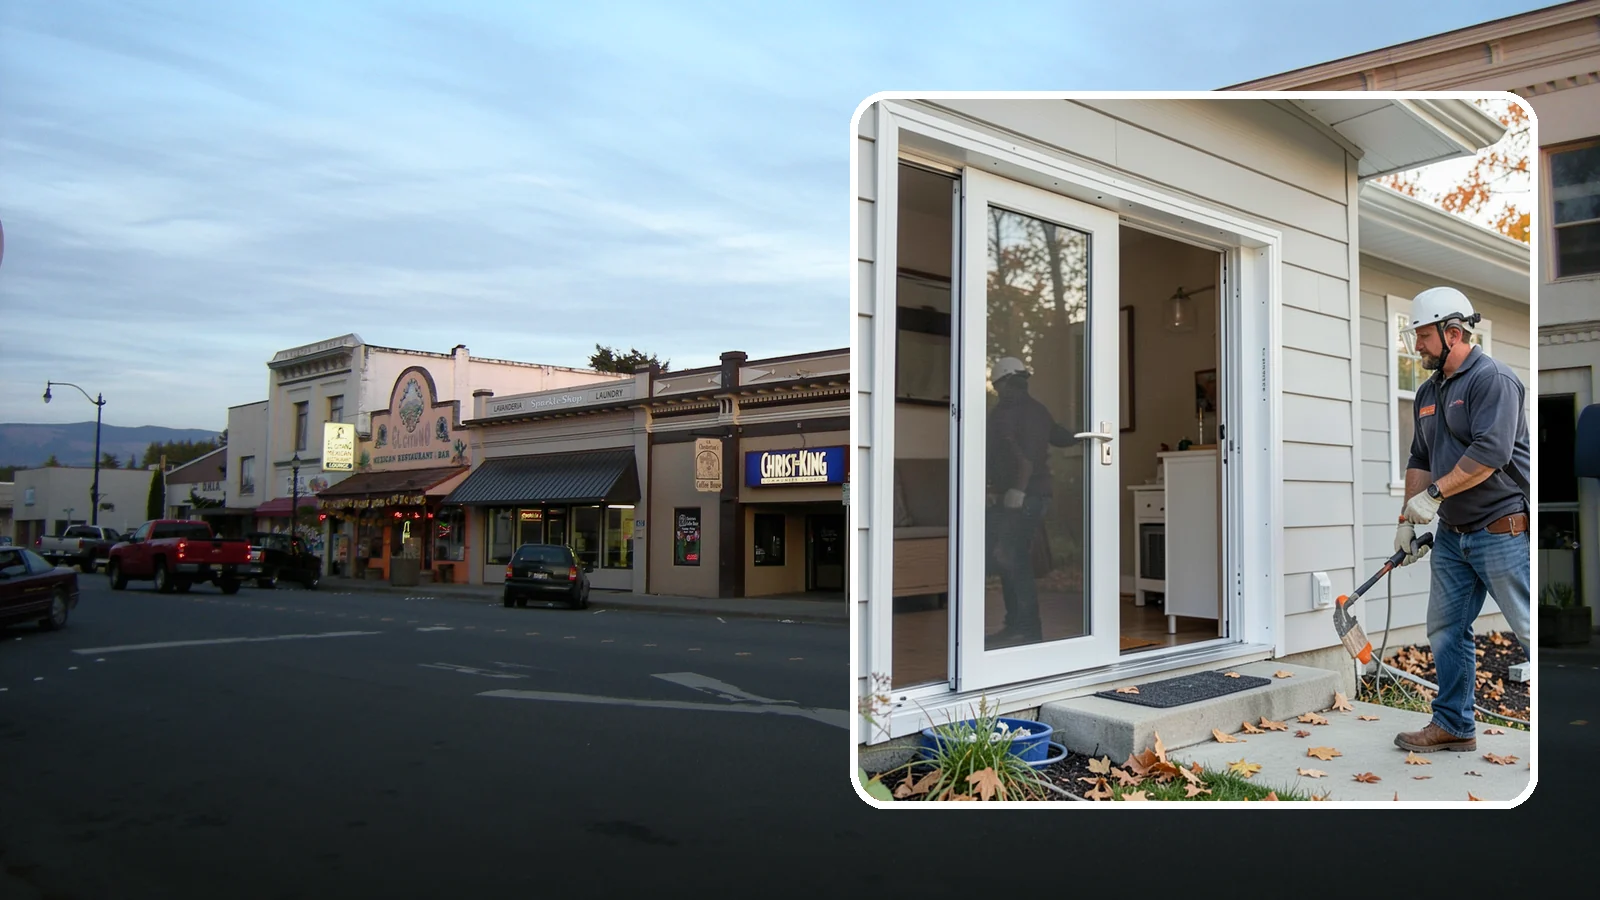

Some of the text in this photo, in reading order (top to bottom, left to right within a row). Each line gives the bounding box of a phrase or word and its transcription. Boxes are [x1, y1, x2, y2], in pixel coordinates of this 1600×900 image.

[493, 389, 623, 412] LAVANDERIA Sparkle Shop LAUNDRY
[373, 450, 450, 464] MEXICAN RESTAURANT BAR
[761, 450, 827, 478] CHRIST KING
[697, 480, 722, 488] Coffee House
